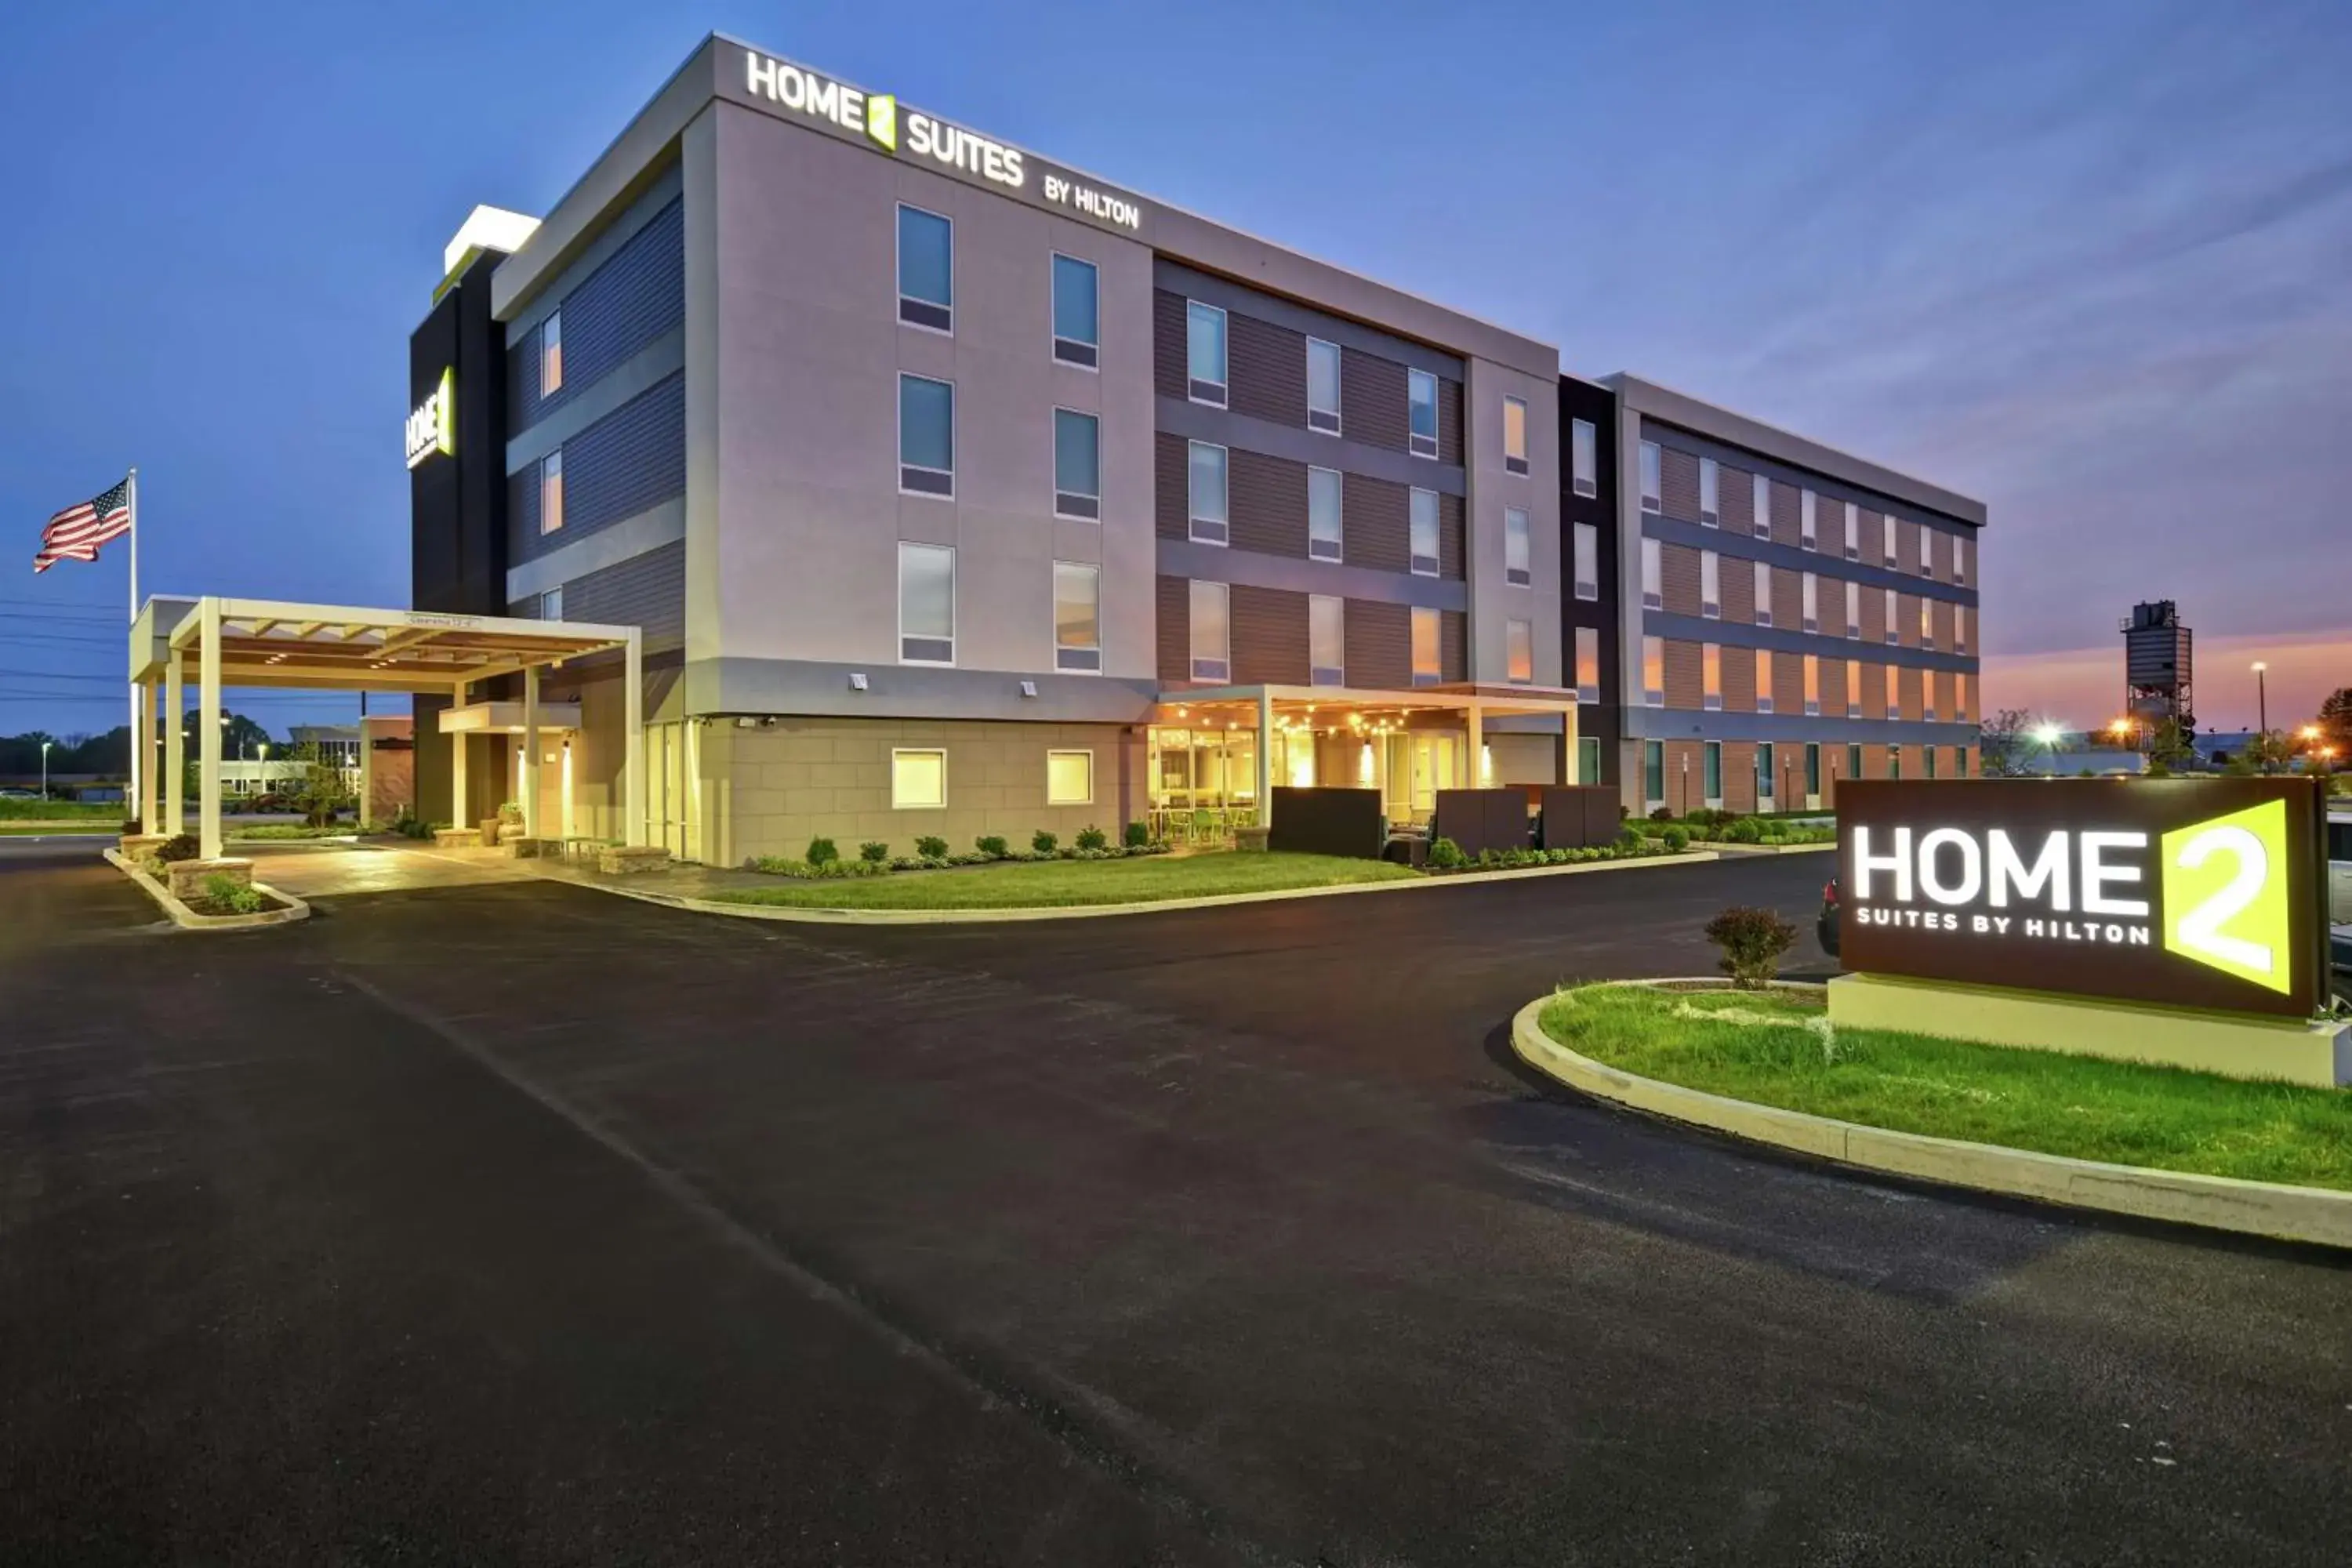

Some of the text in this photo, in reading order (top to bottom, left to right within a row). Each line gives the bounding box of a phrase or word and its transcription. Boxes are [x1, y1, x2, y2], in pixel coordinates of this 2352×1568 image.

[747, 52, 1139, 228] HOME 2 SUITES BY HILTON
[1854, 826, 2273, 973] HOME 2
[1857, 907, 2150, 946] SUITES BY HILTON
